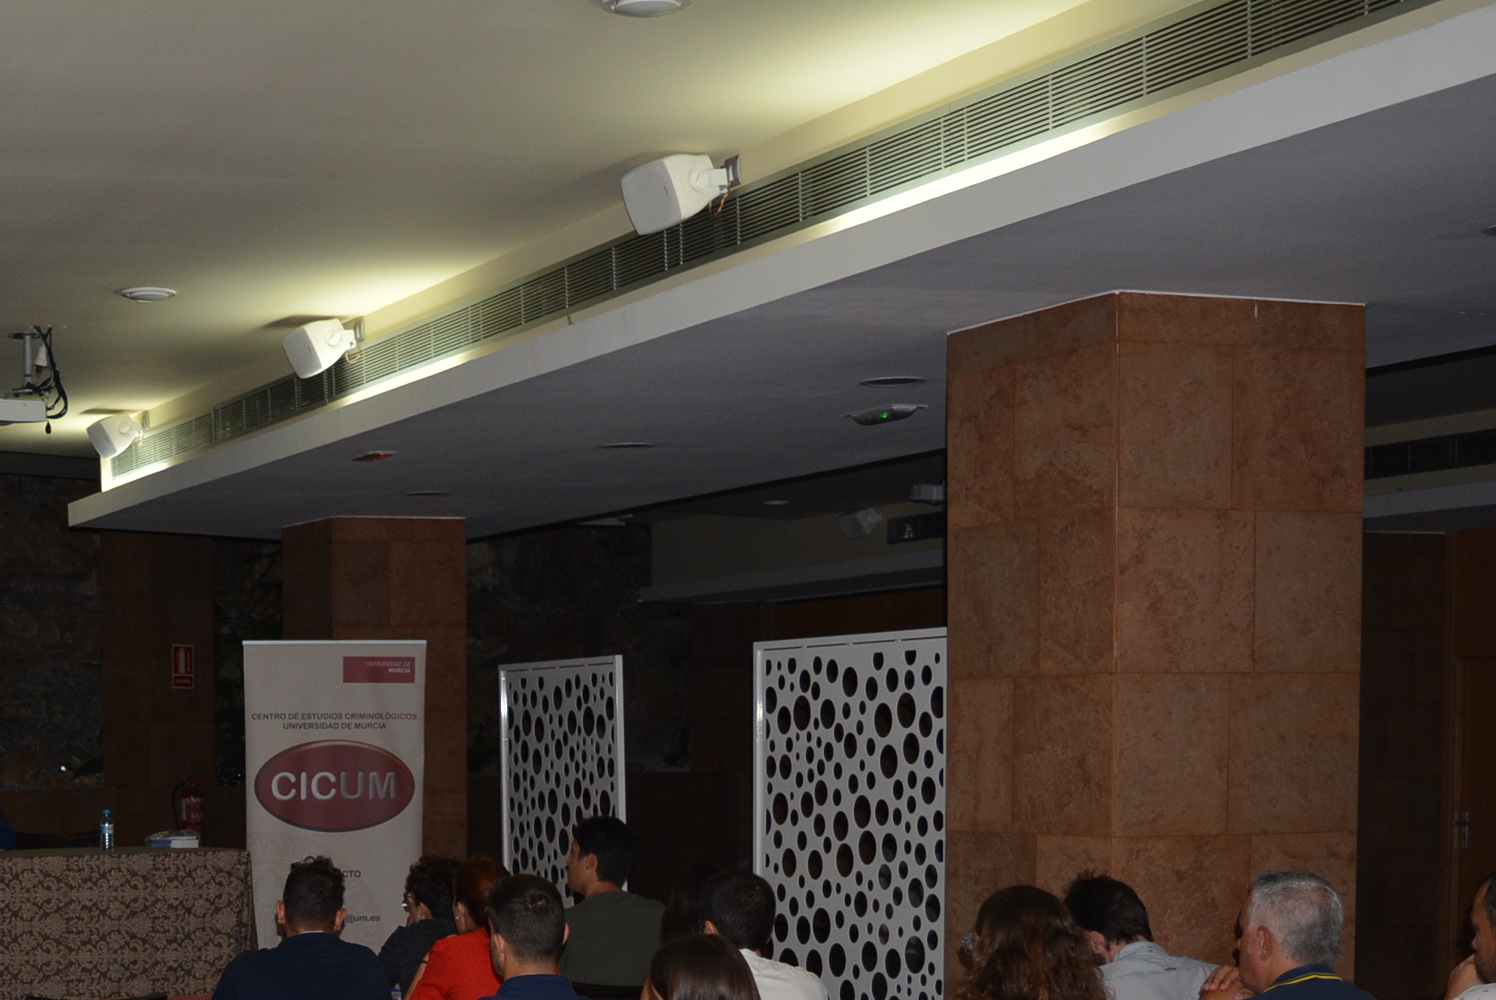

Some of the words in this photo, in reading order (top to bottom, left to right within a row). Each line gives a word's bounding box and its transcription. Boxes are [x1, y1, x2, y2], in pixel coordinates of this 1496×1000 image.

[345, 711, 417, 720] CRIMINOLÓGICOS
[271, 771, 397, 801] CICUM
[342, 870, 362, 878] CTO
